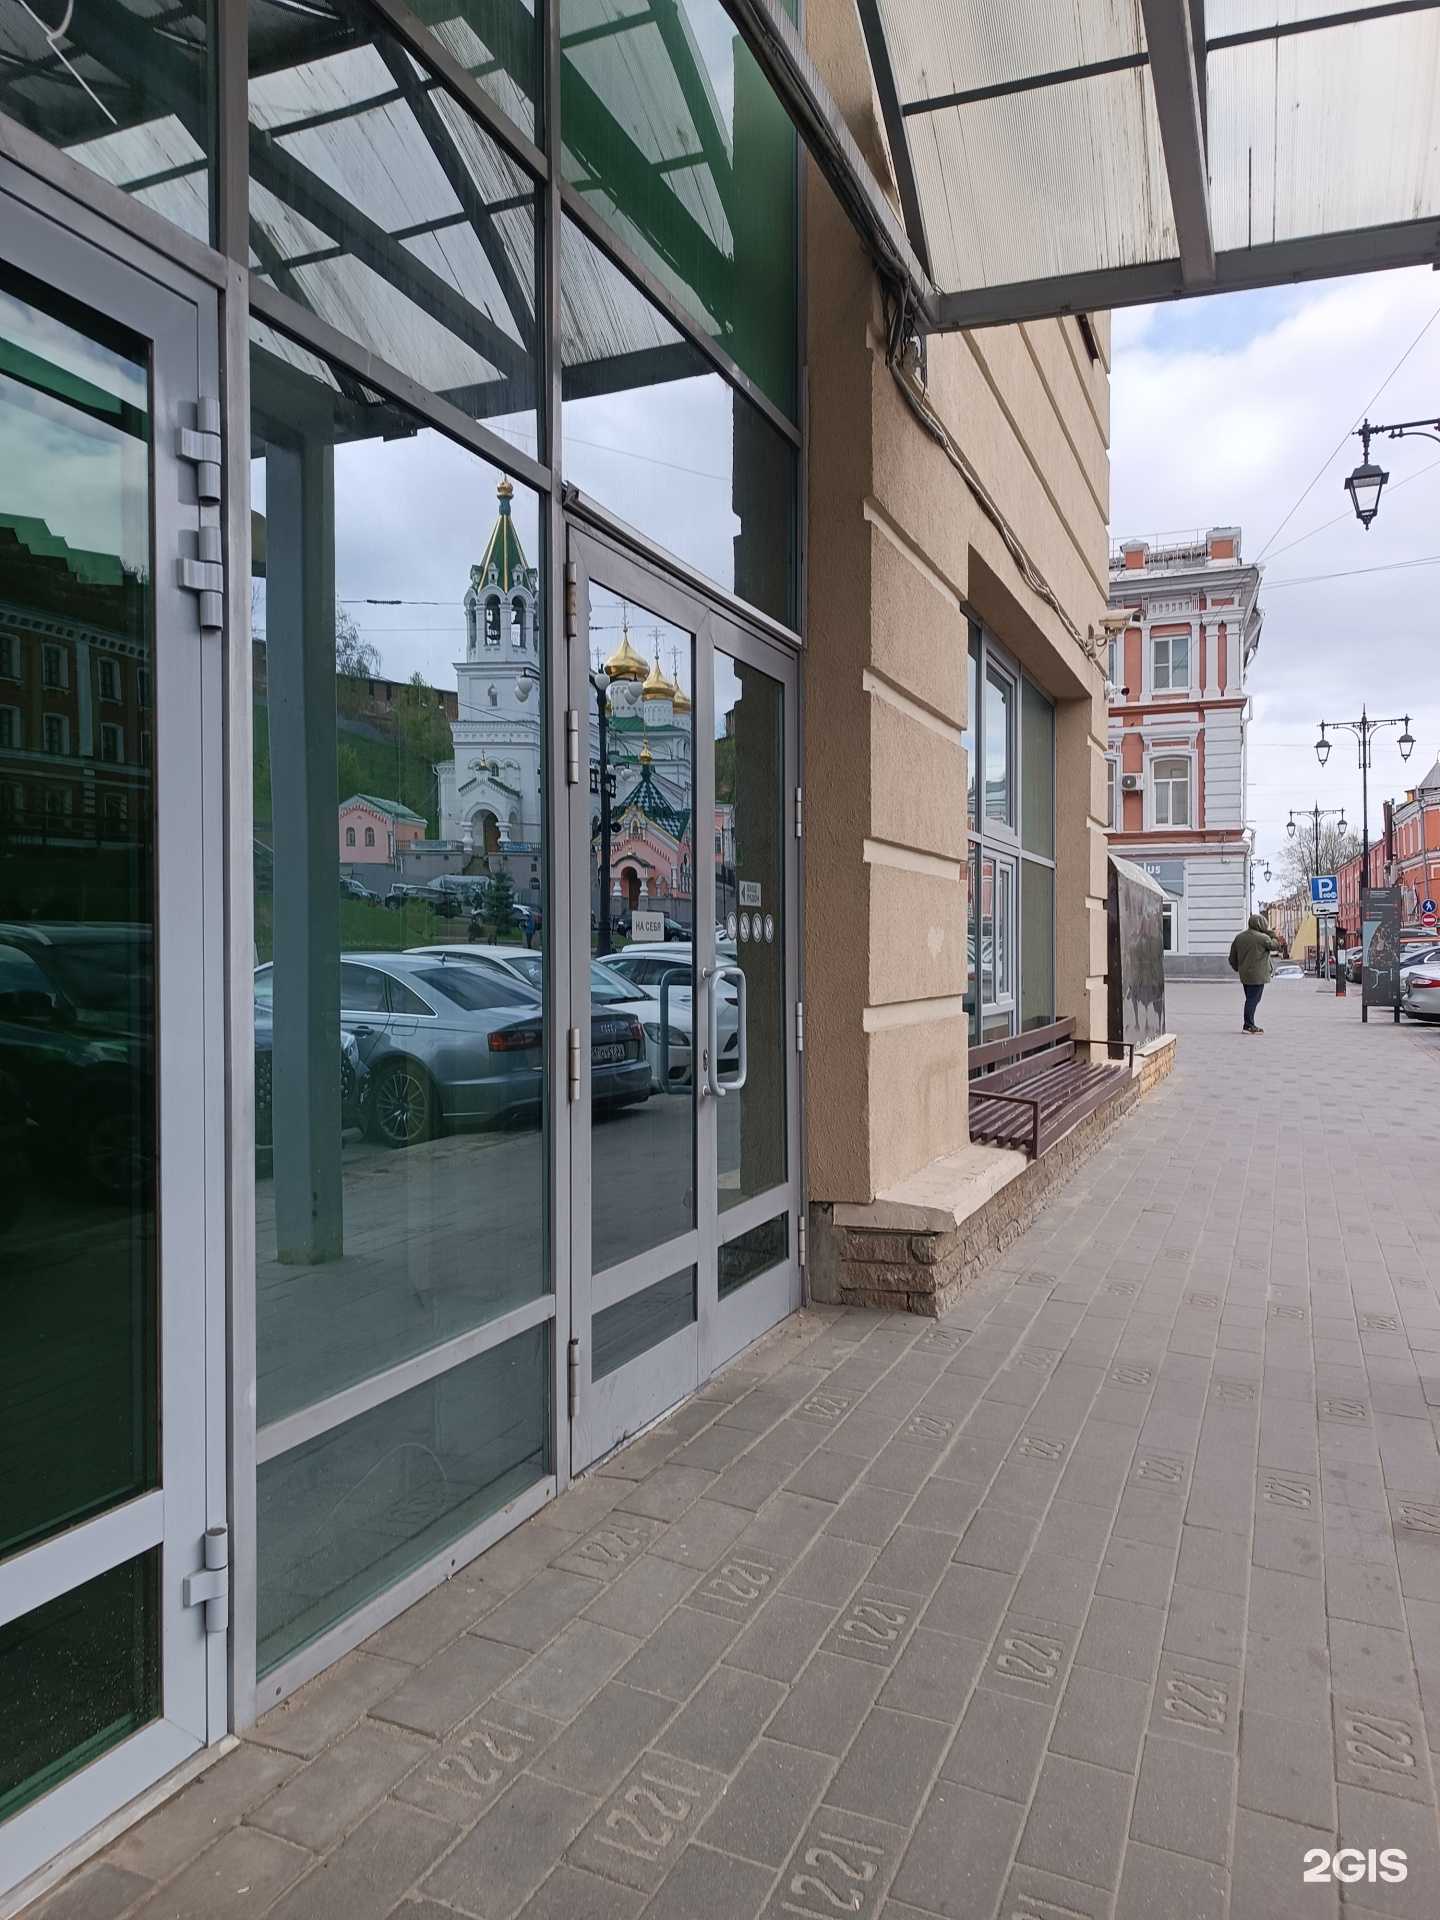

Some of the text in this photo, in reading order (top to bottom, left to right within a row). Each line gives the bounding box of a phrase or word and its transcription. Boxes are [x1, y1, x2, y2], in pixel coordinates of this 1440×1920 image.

[1318, 878, 1333, 898] P
[635, 919, 645, 932] НА
[697, 1557, 777, 1608] 1221
[838, 1598, 912, 1650] 1221
[994, 1628, 1066, 1688] 1221
[1161, 1668, 1230, 1736] 1221
[425, 1718, 537, 1801] 1221
[1344, 1705, 1419, 1780] 1221
[594, 1771, 702, 1862] 1221
